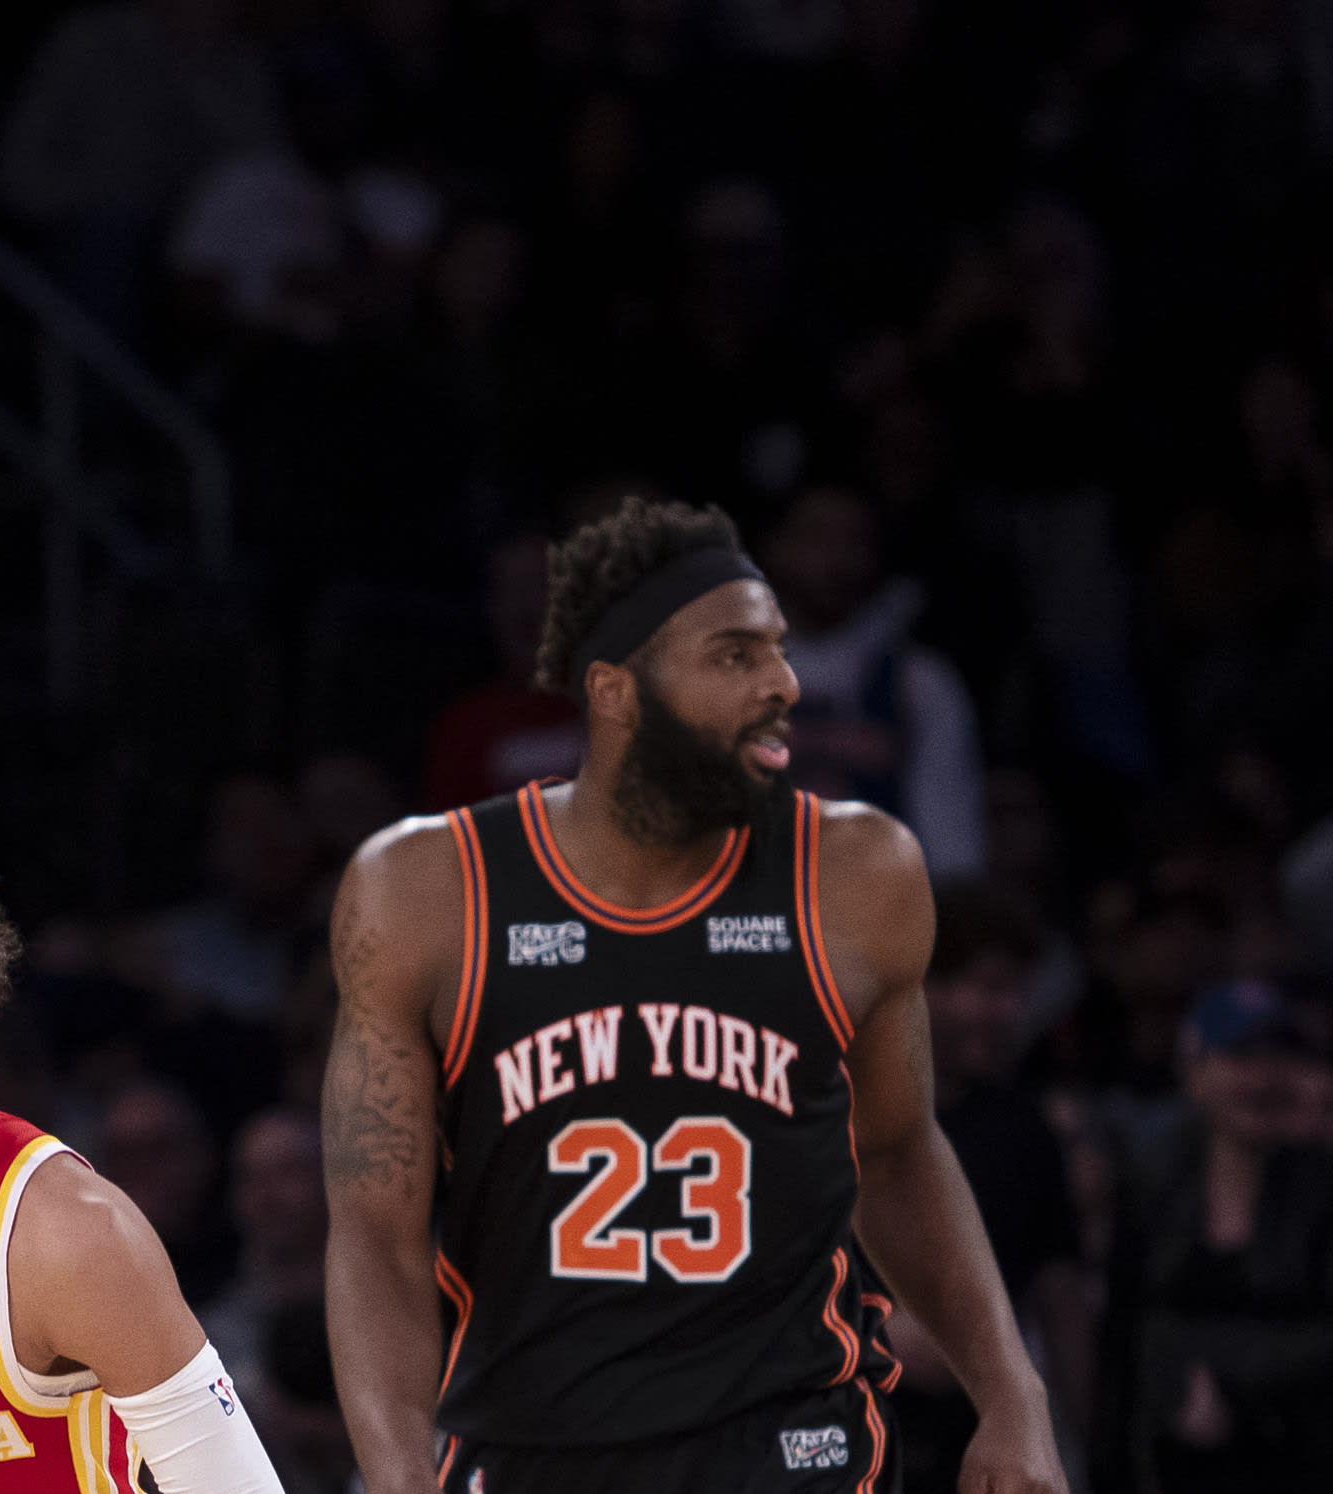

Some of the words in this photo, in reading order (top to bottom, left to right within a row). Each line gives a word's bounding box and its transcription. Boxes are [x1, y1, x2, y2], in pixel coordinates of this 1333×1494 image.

[708, 916, 786, 934] SQUARE
[710, 933, 773, 953] SPACE
[494, 1005, 623, 1126] NEW
[638, 1004, 799, 1117] YORK
[548, 1116, 752, 1283] 23
